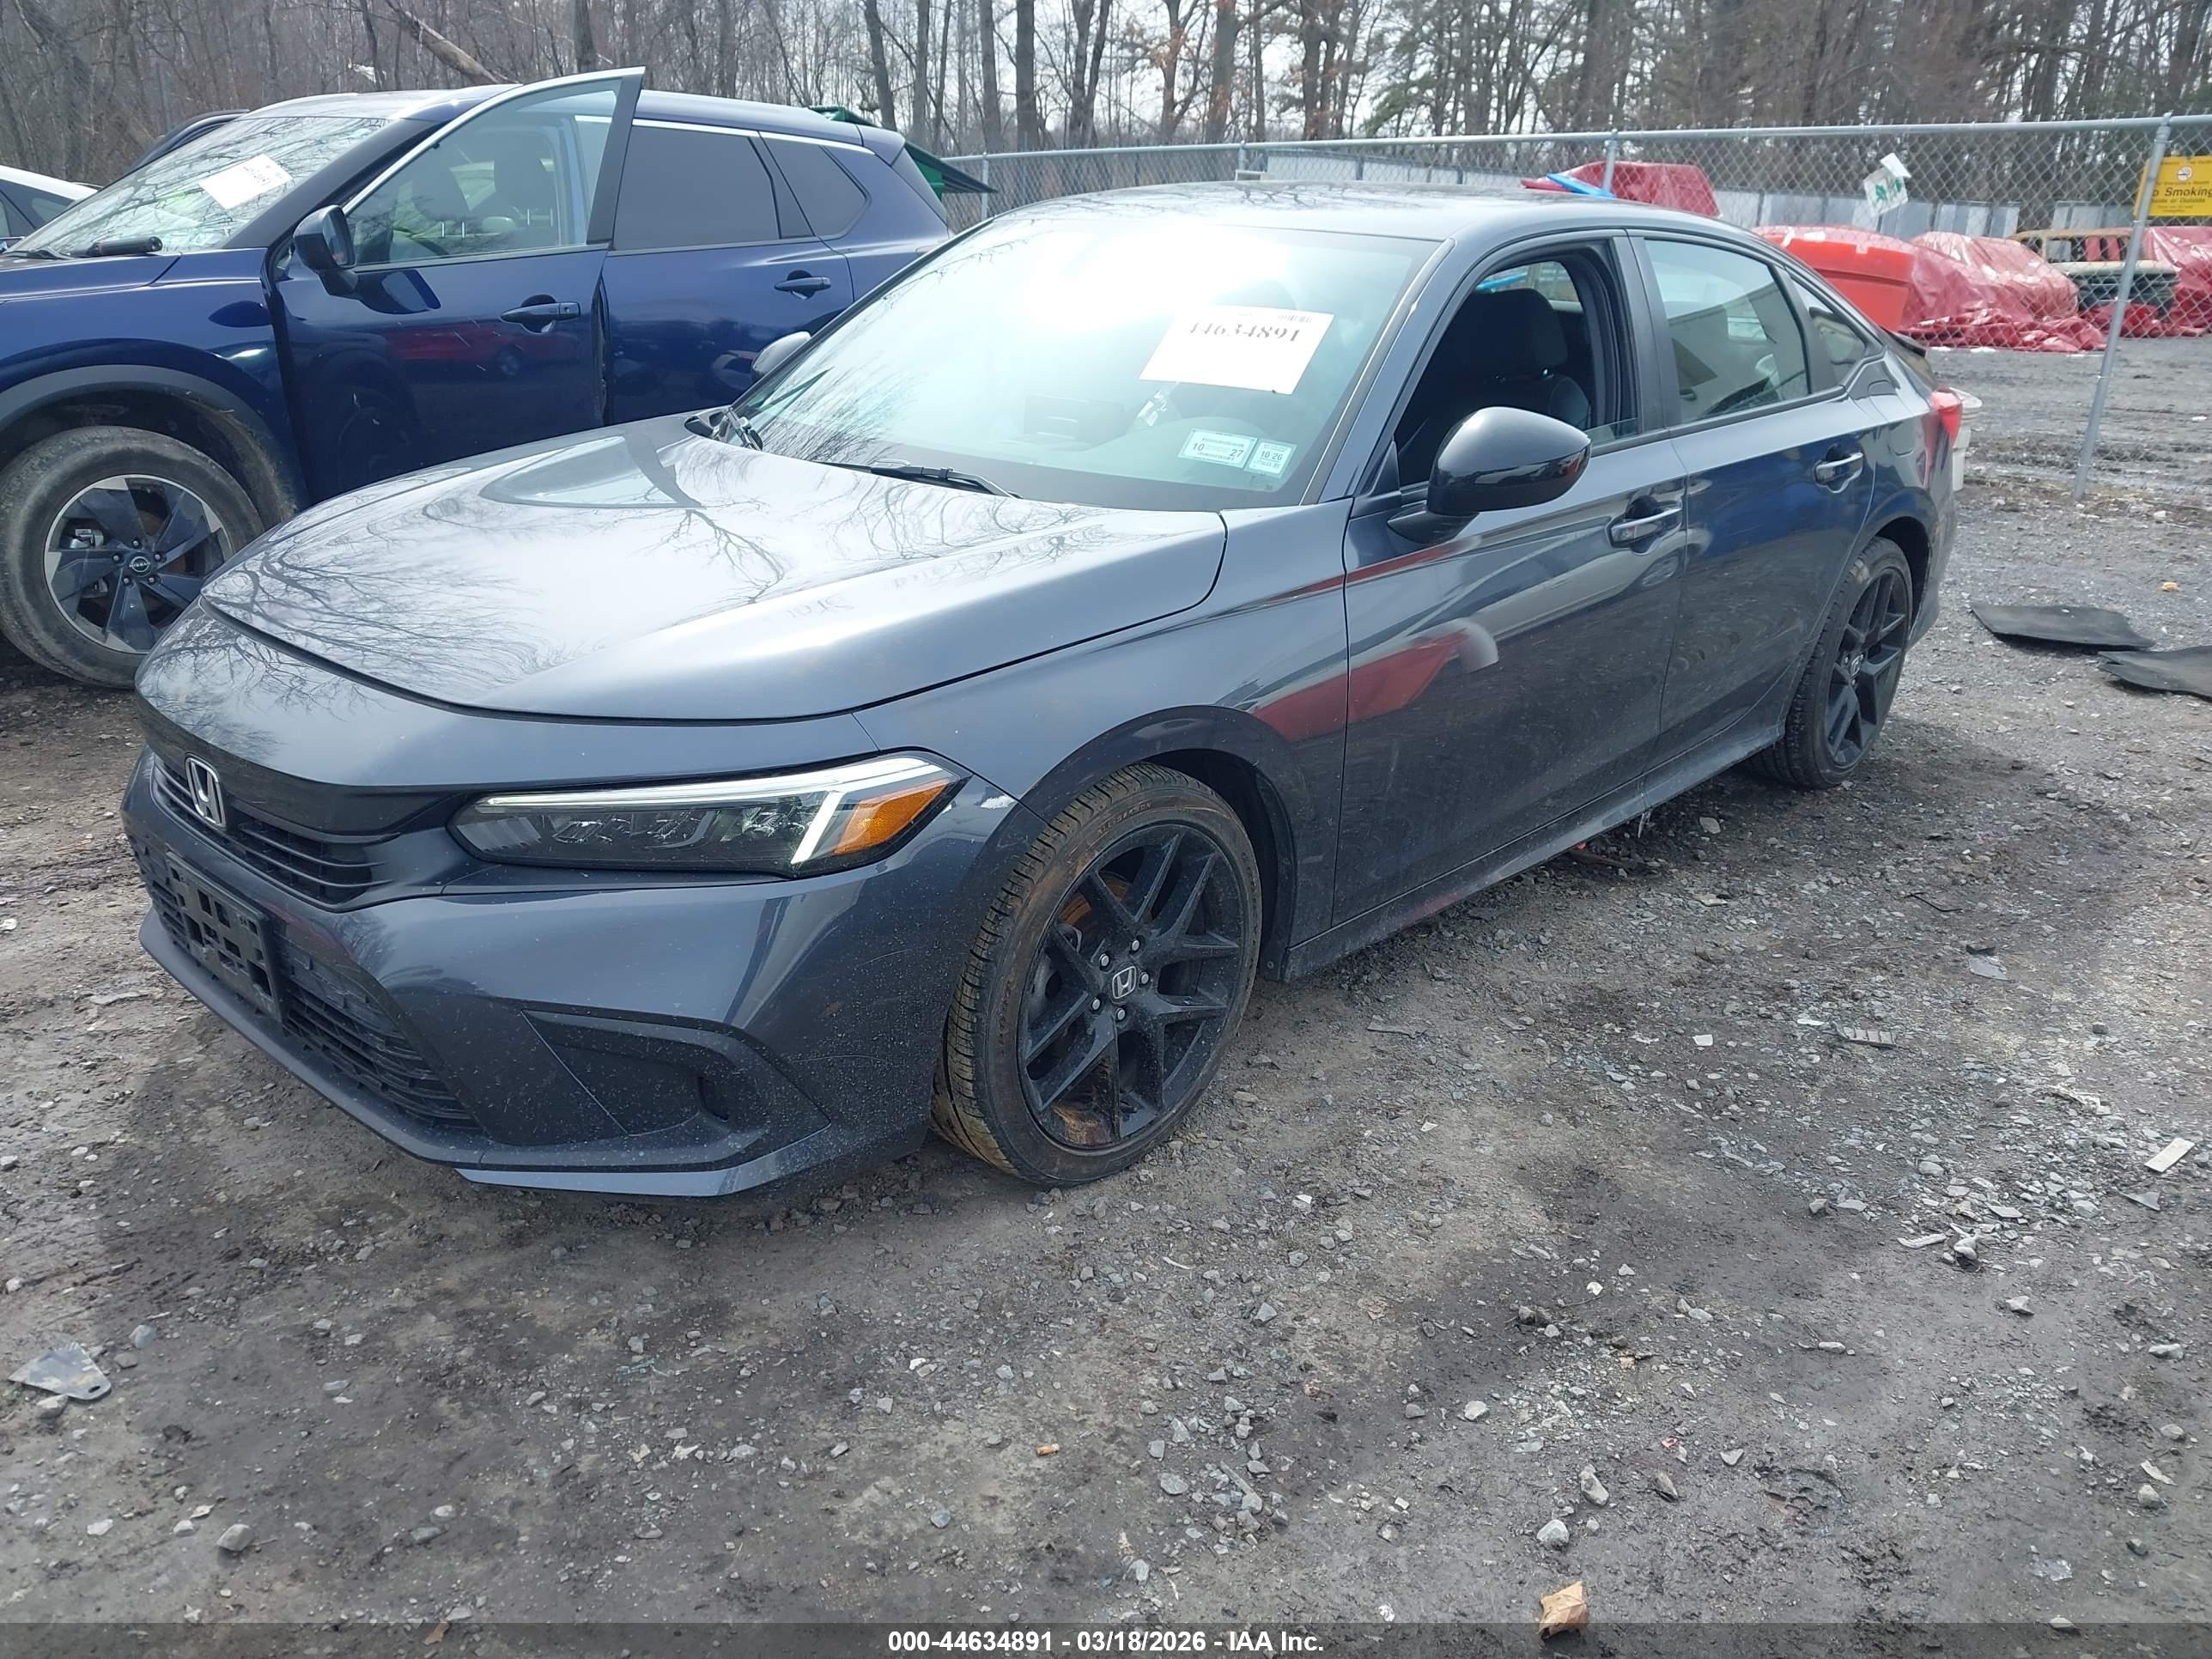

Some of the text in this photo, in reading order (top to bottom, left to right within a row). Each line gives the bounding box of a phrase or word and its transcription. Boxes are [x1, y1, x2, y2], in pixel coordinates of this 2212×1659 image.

[2164, 187, 2212, 198] Smoking
[1192, 443, 1205, 452] 10
[1229, 448, 1244, 459] 27
[1261, 450, 1271, 459] 10
